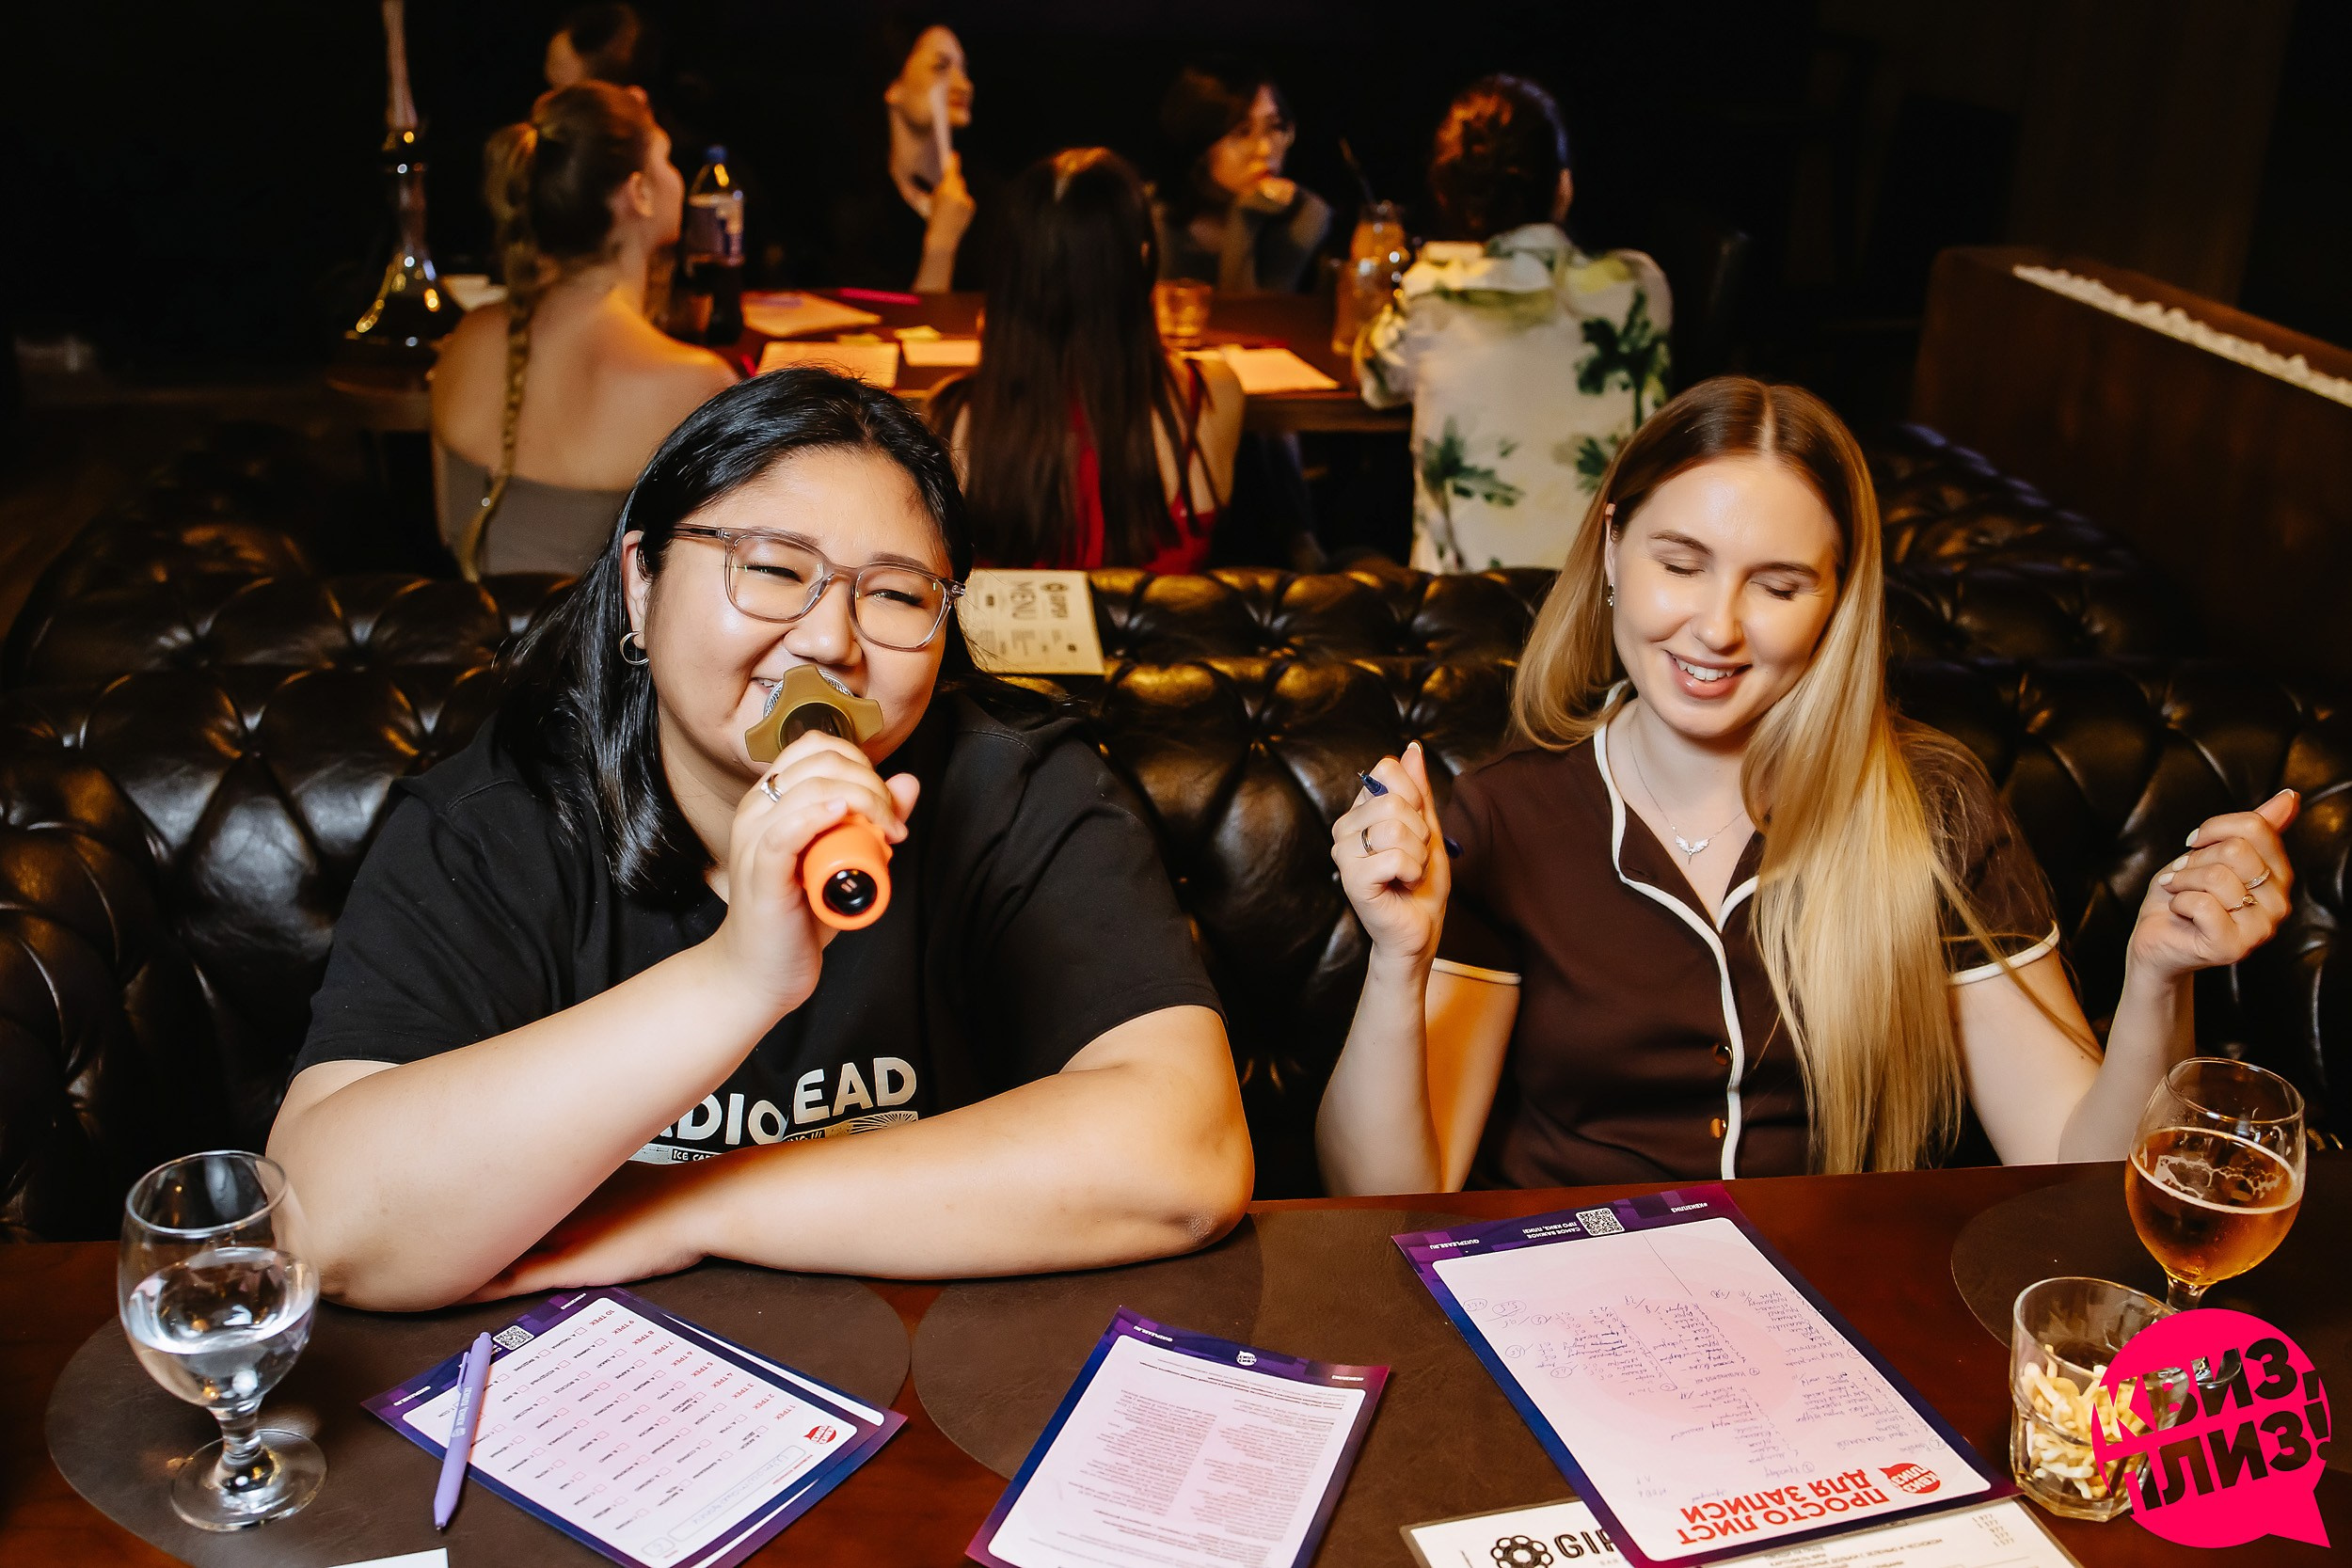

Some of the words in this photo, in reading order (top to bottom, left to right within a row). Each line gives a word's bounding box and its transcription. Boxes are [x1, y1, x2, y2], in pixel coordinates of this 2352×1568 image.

[673, 1149, 689, 1161] ICE
[1671, 1203, 1708, 1212] #КВИЗПЛИЗ
[1430, 1239, 1479, 1249] QUIZPLEASE.RU
[589, 1315, 607, 1325] ТРЕК
[612, 1323, 629, 1335] ТРЕК
[632, 1335, 650, 1345] ТРЕК
[651, 1344, 669, 1355] ТРЕК
[671, 1355, 689, 1366] ТРЕК
[691, 1366, 708, 1377] ТРЕК
[711, 1376, 728, 1387] ТРЕК
[732, 1387, 750, 1399] ТРЕК
[753, 1398, 770, 1409] ТРЕК
[774, 1408, 792, 1420] ТРЕК
[1808, 1469, 1871, 1497] ДЛЯ
[1681, 1486, 1805, 1523] ЗАПИСИ
[1764, 1489, 1888, 1525] ПРОСТО
[1677, 1515, 1757, 1544] ЛИСТ
